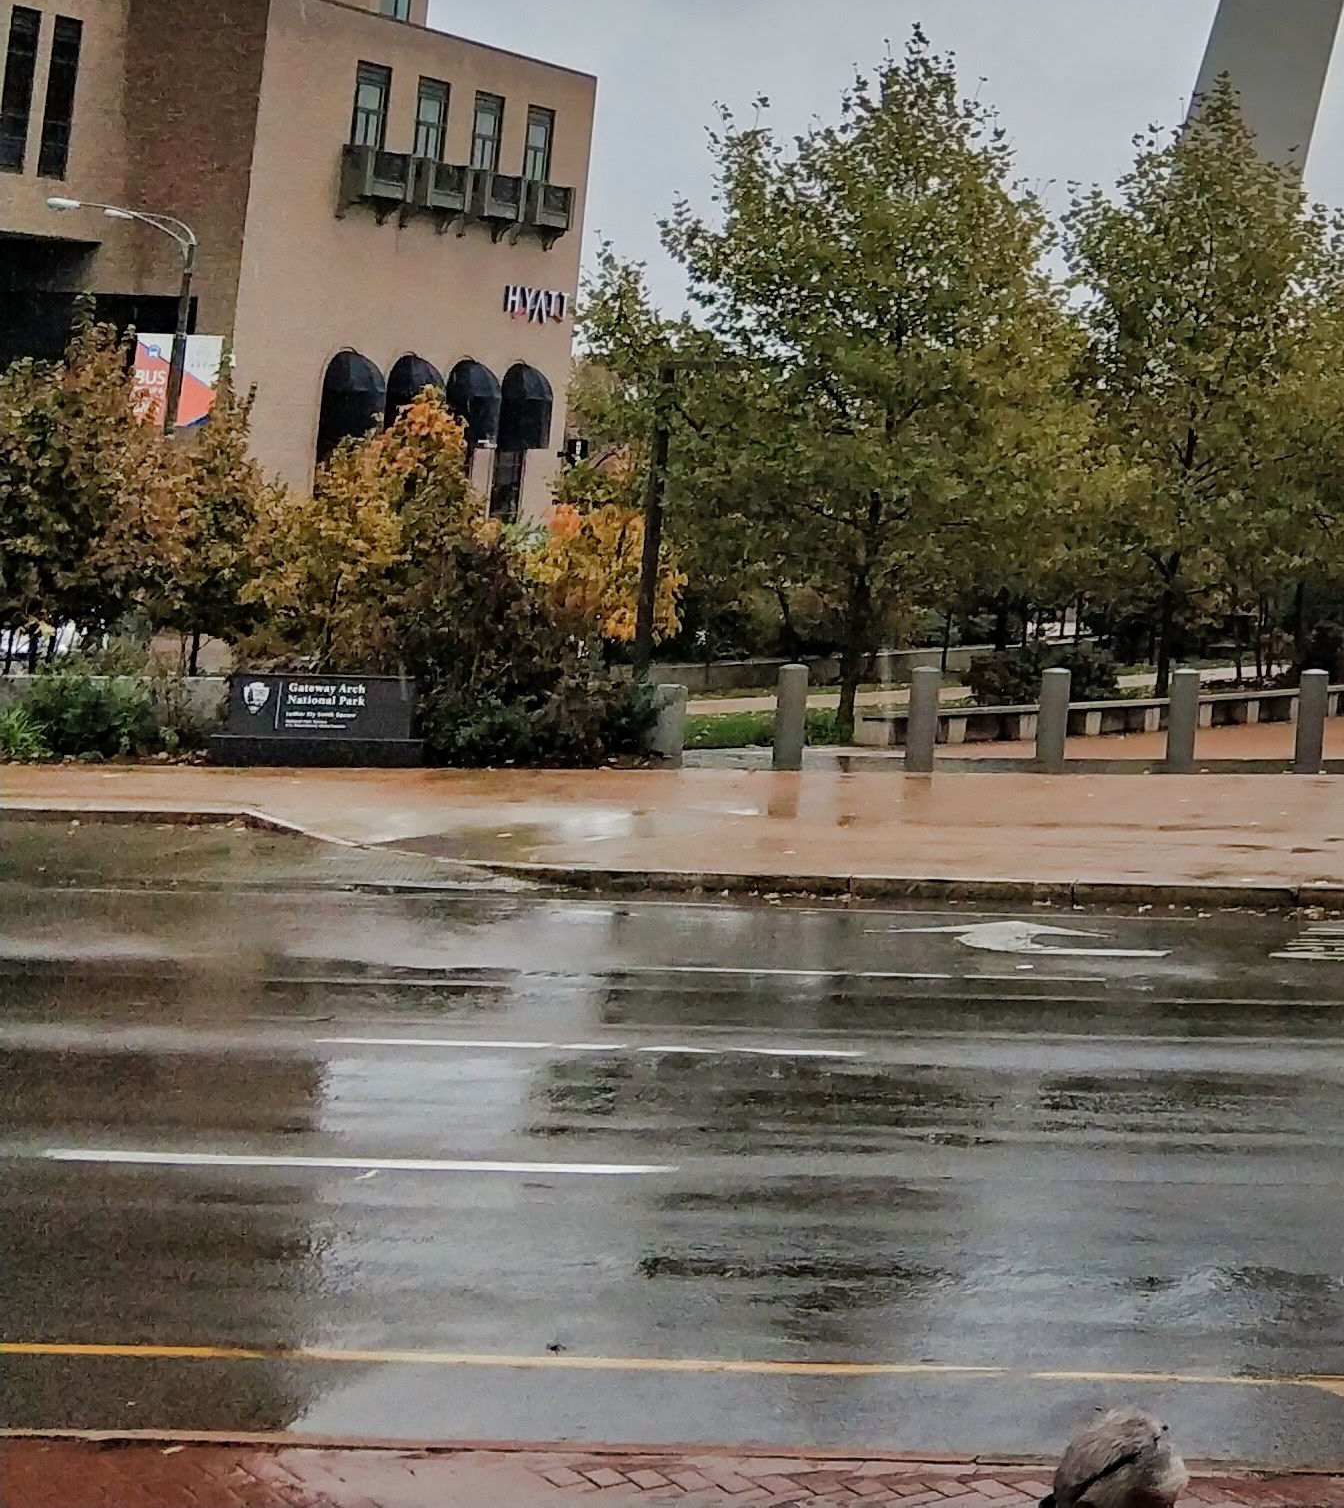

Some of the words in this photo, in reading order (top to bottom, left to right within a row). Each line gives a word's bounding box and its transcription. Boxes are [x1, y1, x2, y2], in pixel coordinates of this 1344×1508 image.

[504, 284, 571, 324] HYATT
[135, 369, 167, 385] BUS
[288, 682, 337, 696] Gateway
[338, 683, 366, 694] Arch
[286, 695, 337, 705] National
[338, 696, 366, 706] Park
